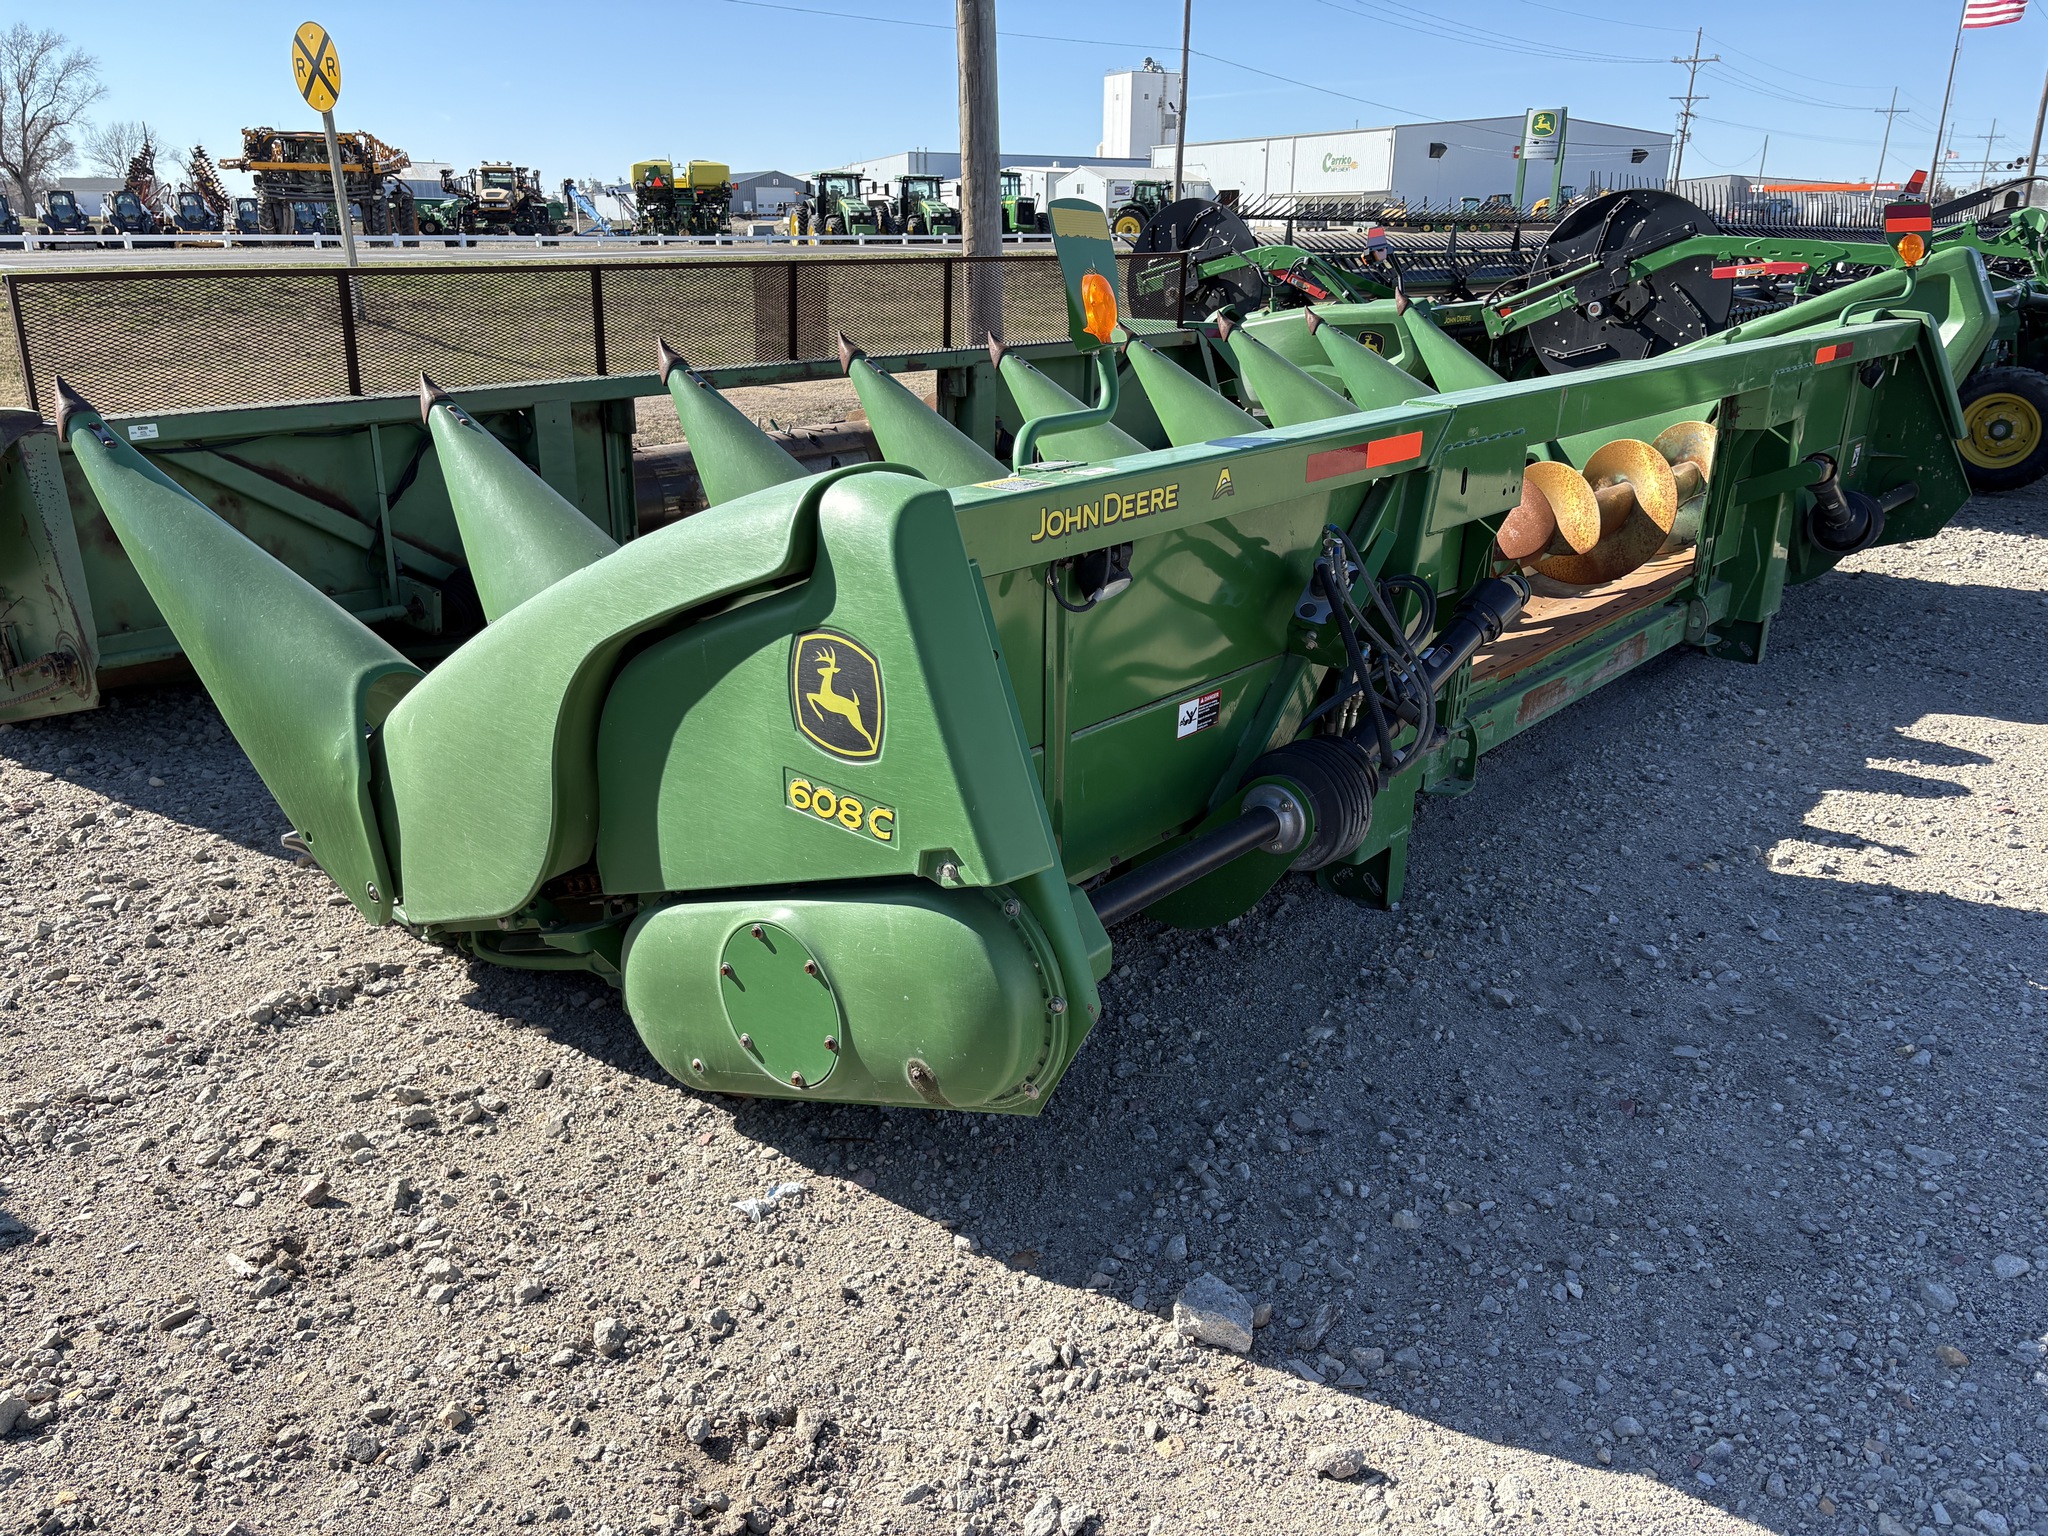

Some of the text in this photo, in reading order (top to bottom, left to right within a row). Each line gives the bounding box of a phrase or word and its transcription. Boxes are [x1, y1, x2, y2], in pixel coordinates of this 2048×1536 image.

[296, 57, 307, 78] R
[326, 56, 337, 77] R
[1322, 152, 1352, 173] Carrico
[1444, 315, 1472, 324] JOHN DEERE
[1030, 483, 1180, 543] JOHN DEERE
